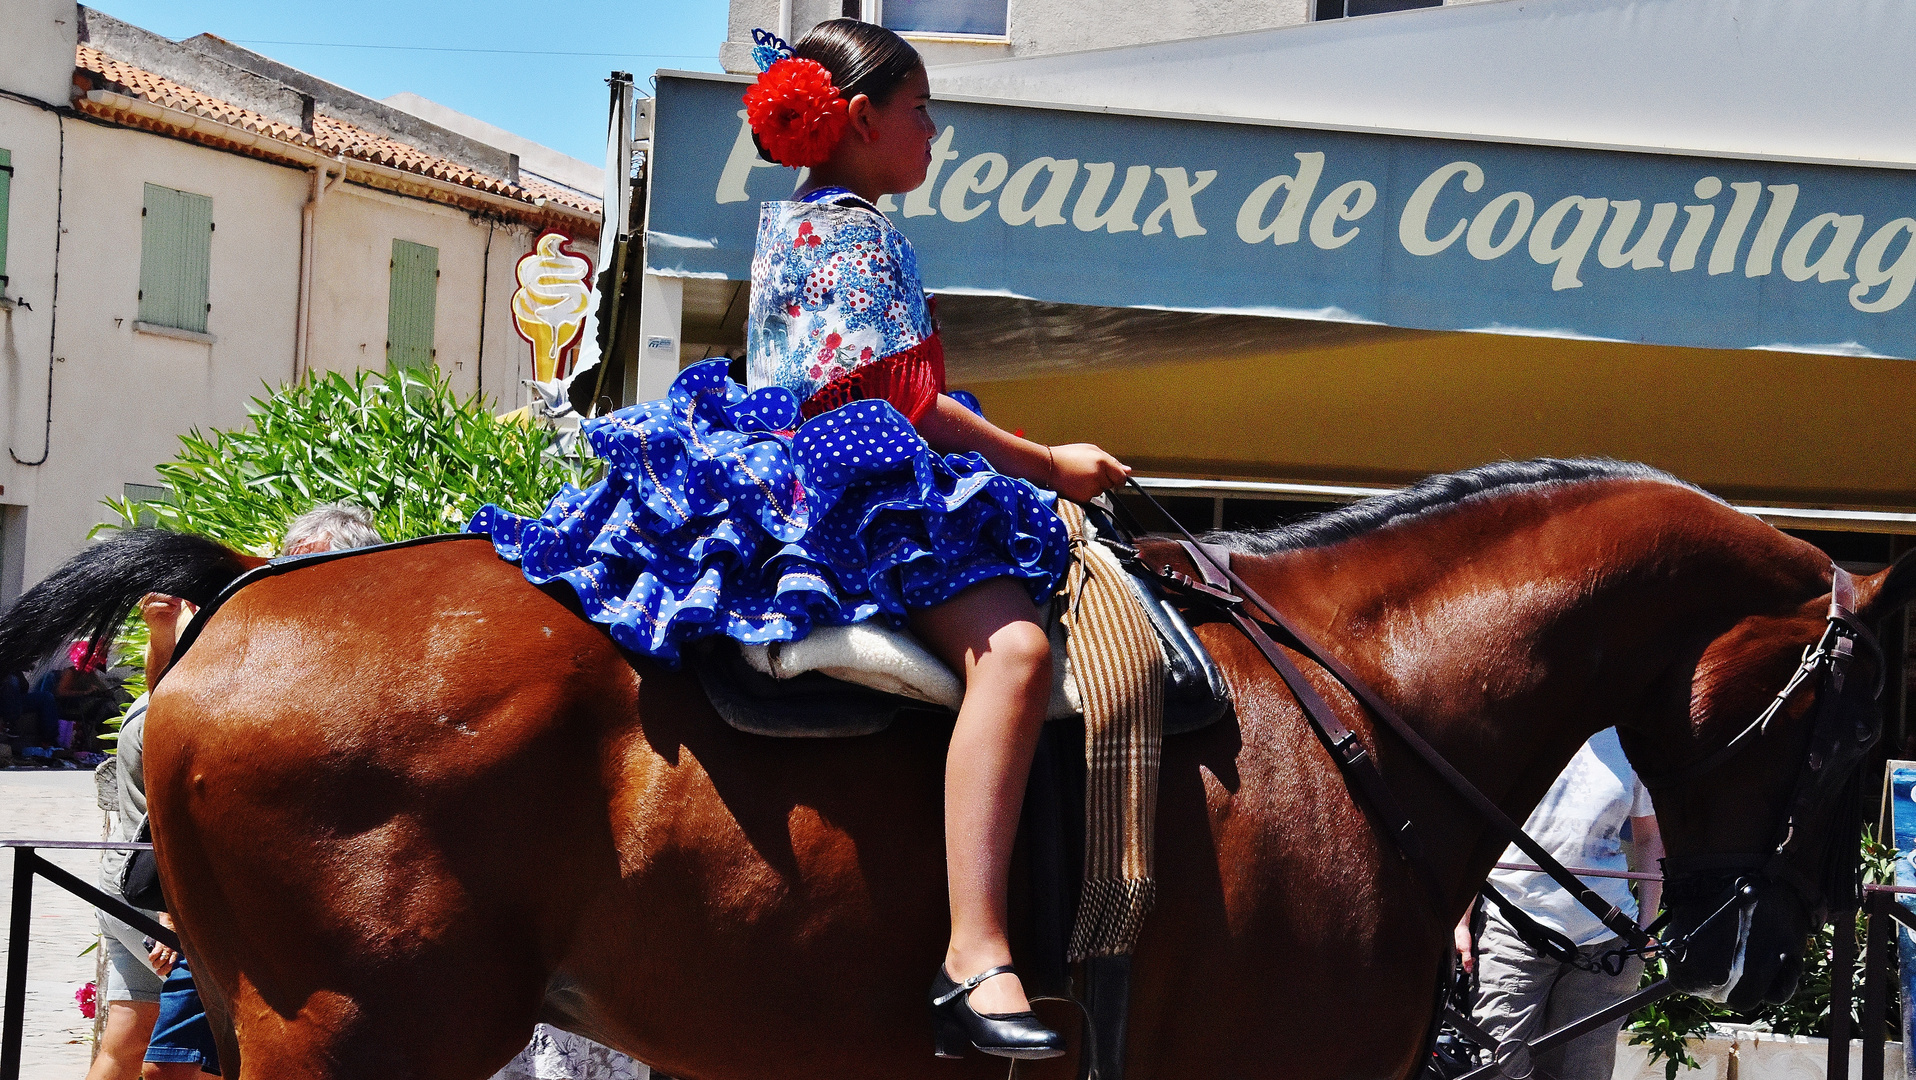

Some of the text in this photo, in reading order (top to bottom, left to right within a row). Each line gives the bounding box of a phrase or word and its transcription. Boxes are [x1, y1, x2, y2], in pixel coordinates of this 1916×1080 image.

[716, 110, 1916, 313] Pteaux de Coquillag
